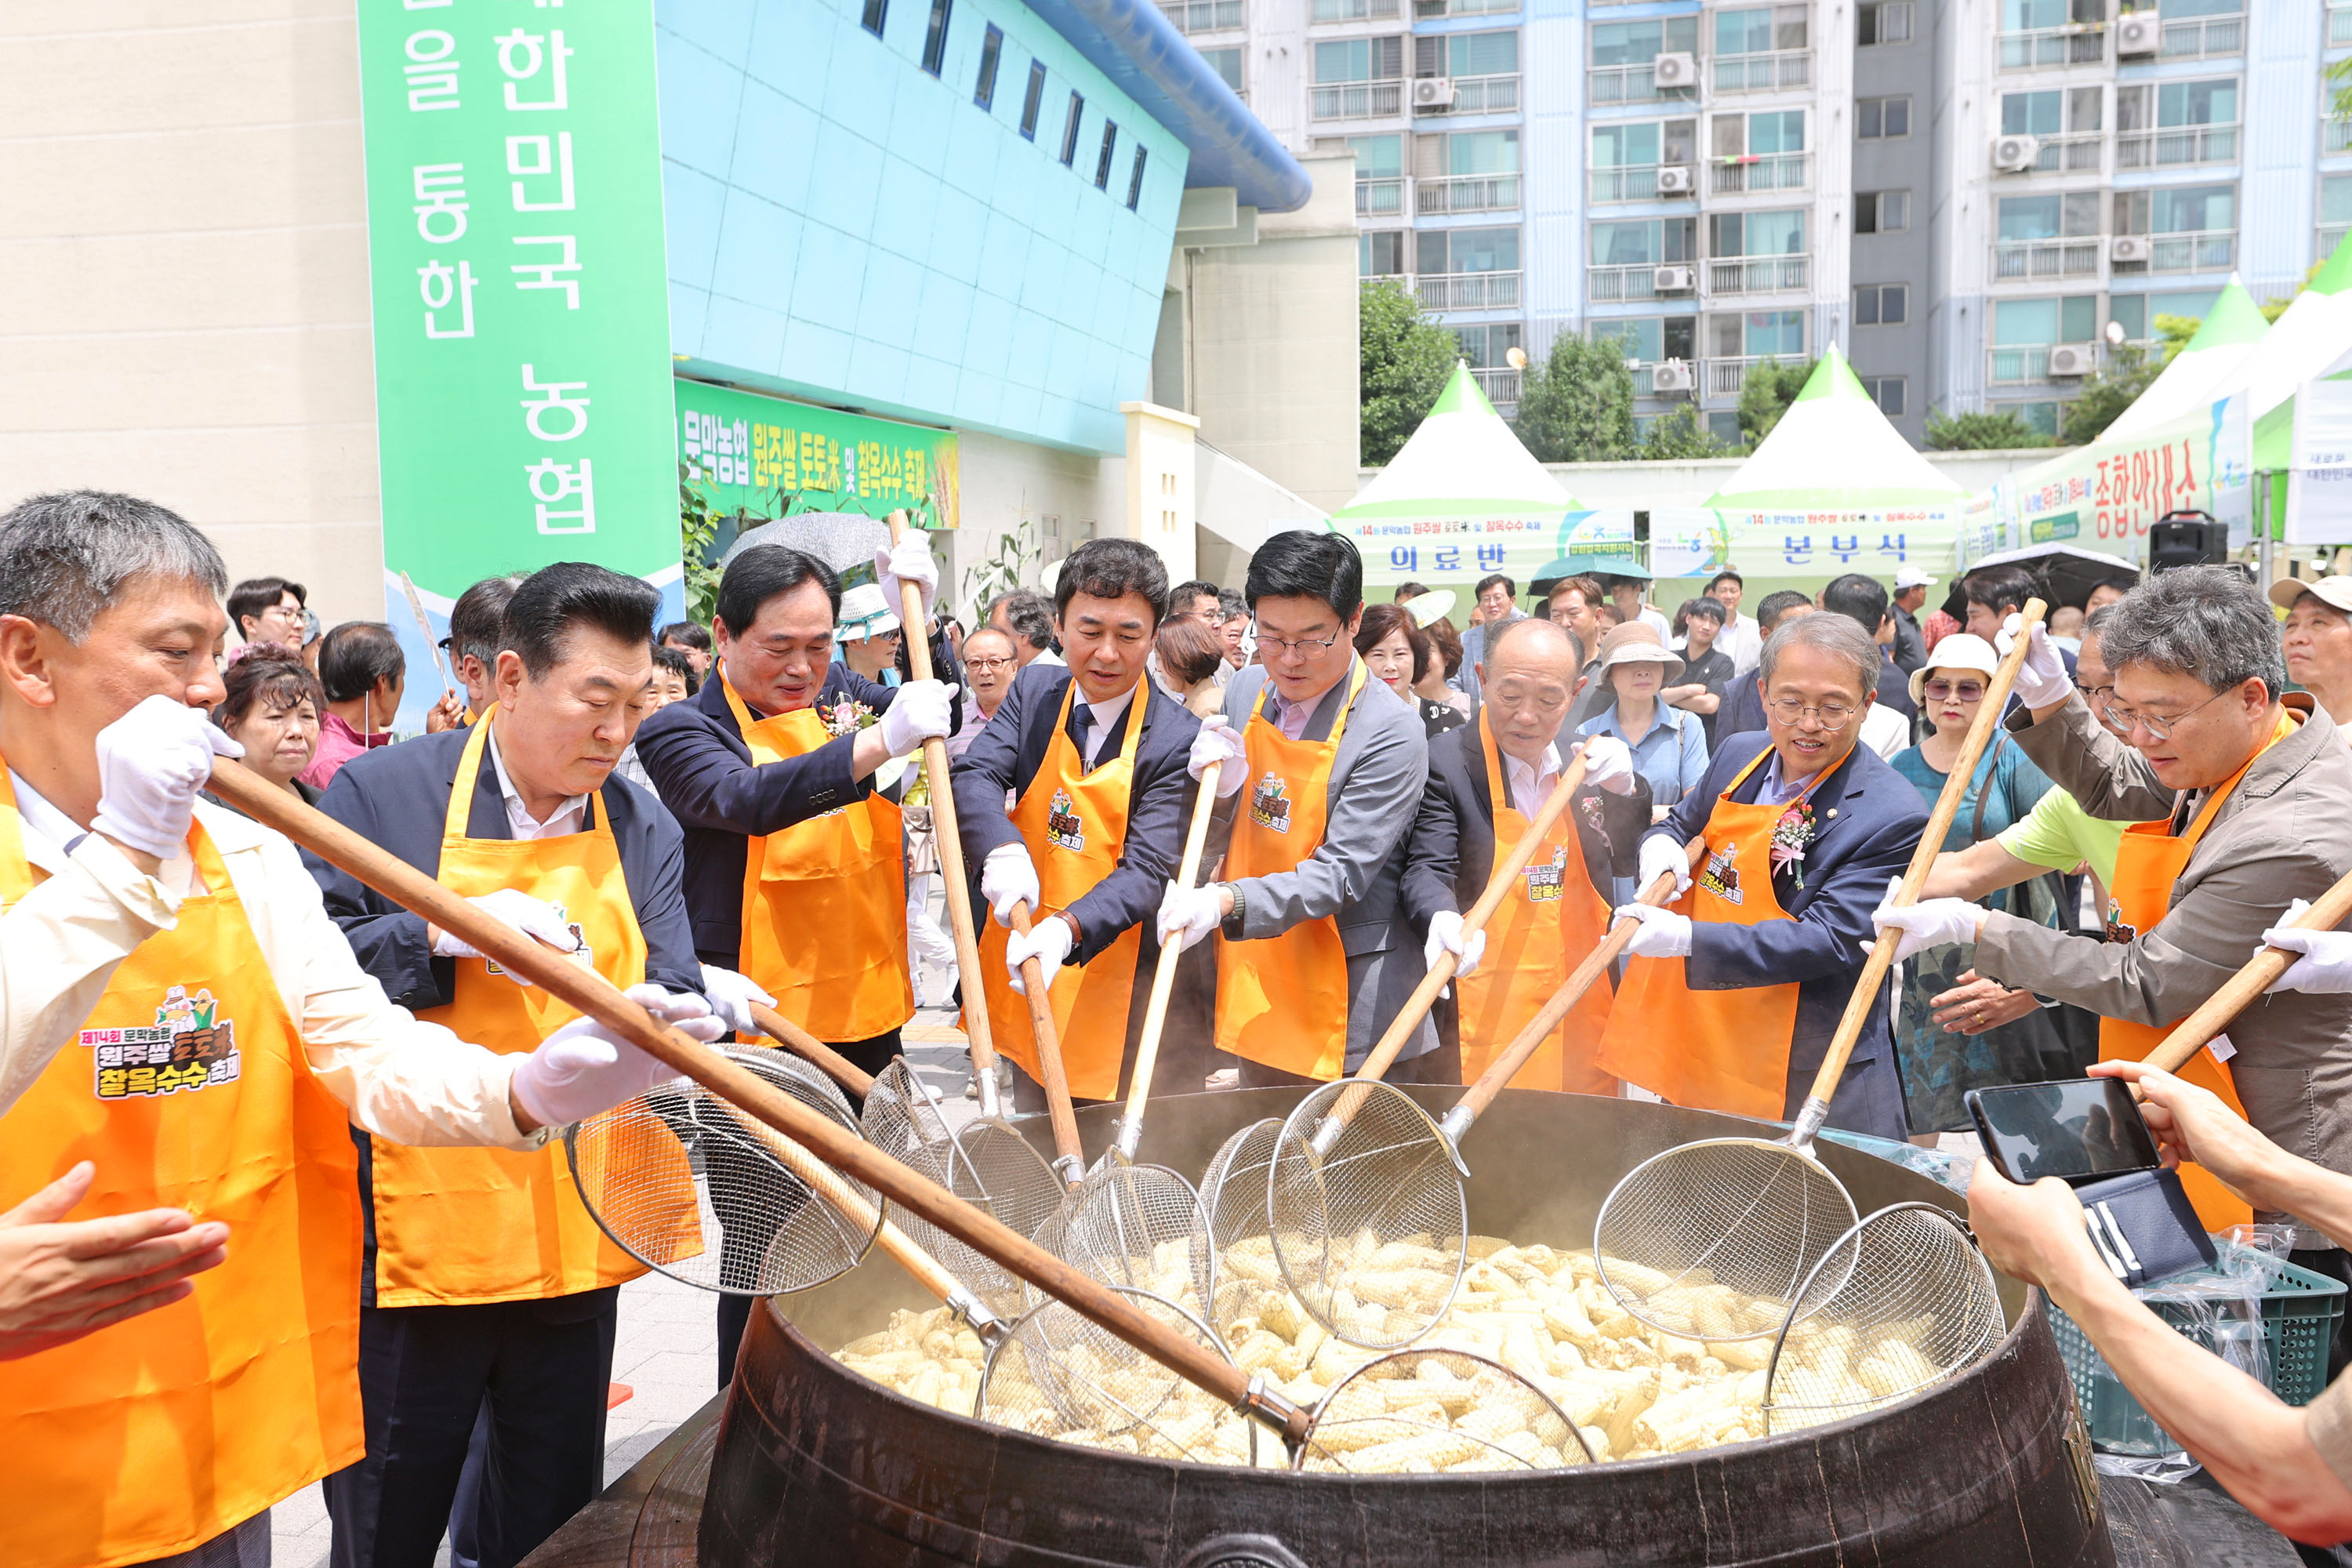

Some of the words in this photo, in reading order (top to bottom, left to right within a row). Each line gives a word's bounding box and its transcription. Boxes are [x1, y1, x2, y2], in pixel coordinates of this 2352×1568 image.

[492, 0, 583, 310] 한민국
[412, 162, 479, 339] 통한
[519, 362, 597, 535] 농협
[684, 409, 750, 487] 문막농협
[753, 423, 797, 491] 원주쌀
[844, 446, 856, 494] 및
[857, 439, 903, 501] 찰옥수수
[905, 445, 926, 502] 축제
[2096, 438, 2198, 539] 종합안내소
[1413, 521, 1442, 535] 원주쌀
[1060, 833, 1083, 850] 축제
[1271, 816, 1289, 832] 축제
[1700, 871, 1725, 895] 찰옥수수
[1725, 887, 1742, 904] 축제
[81, 1029, 122, 1045] 제14회
[124, 1026, 171, 1043] 문막농협
[99, 1043, 171, 1068] 원주쌀
[99, 1061, 208, 1097] 찰옥수수
[209, 1051, 239, 1083] 축제
